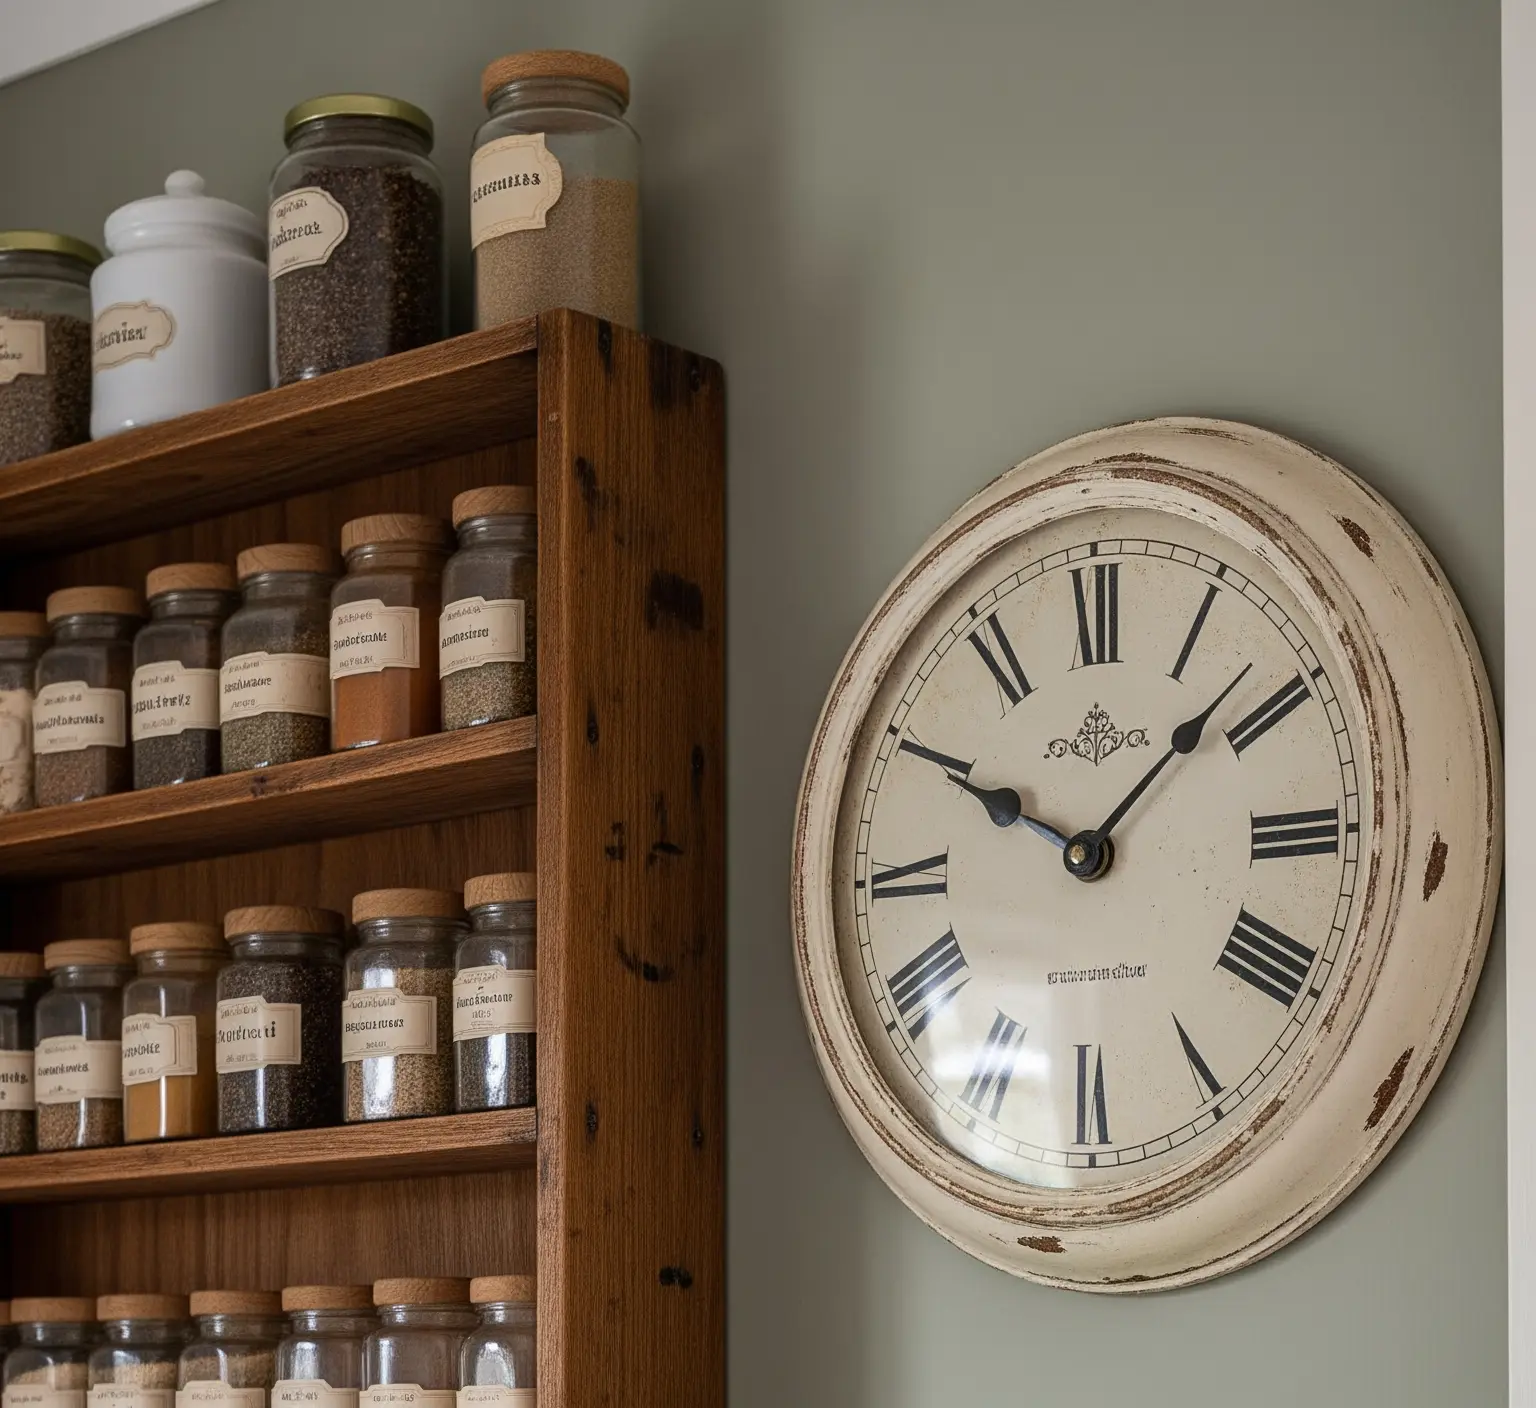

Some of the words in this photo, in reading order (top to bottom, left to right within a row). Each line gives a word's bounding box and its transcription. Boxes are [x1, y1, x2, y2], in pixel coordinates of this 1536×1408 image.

[964, 607, 1039, 720] XI
[1067, 562, 1124, 671] XII
[1165, 581, 1223, 684] I
[1222, 669, 1314, 762] II
[1249, 800, 1339, 868] III
[1213, 903, 1319, 1013] IIII
